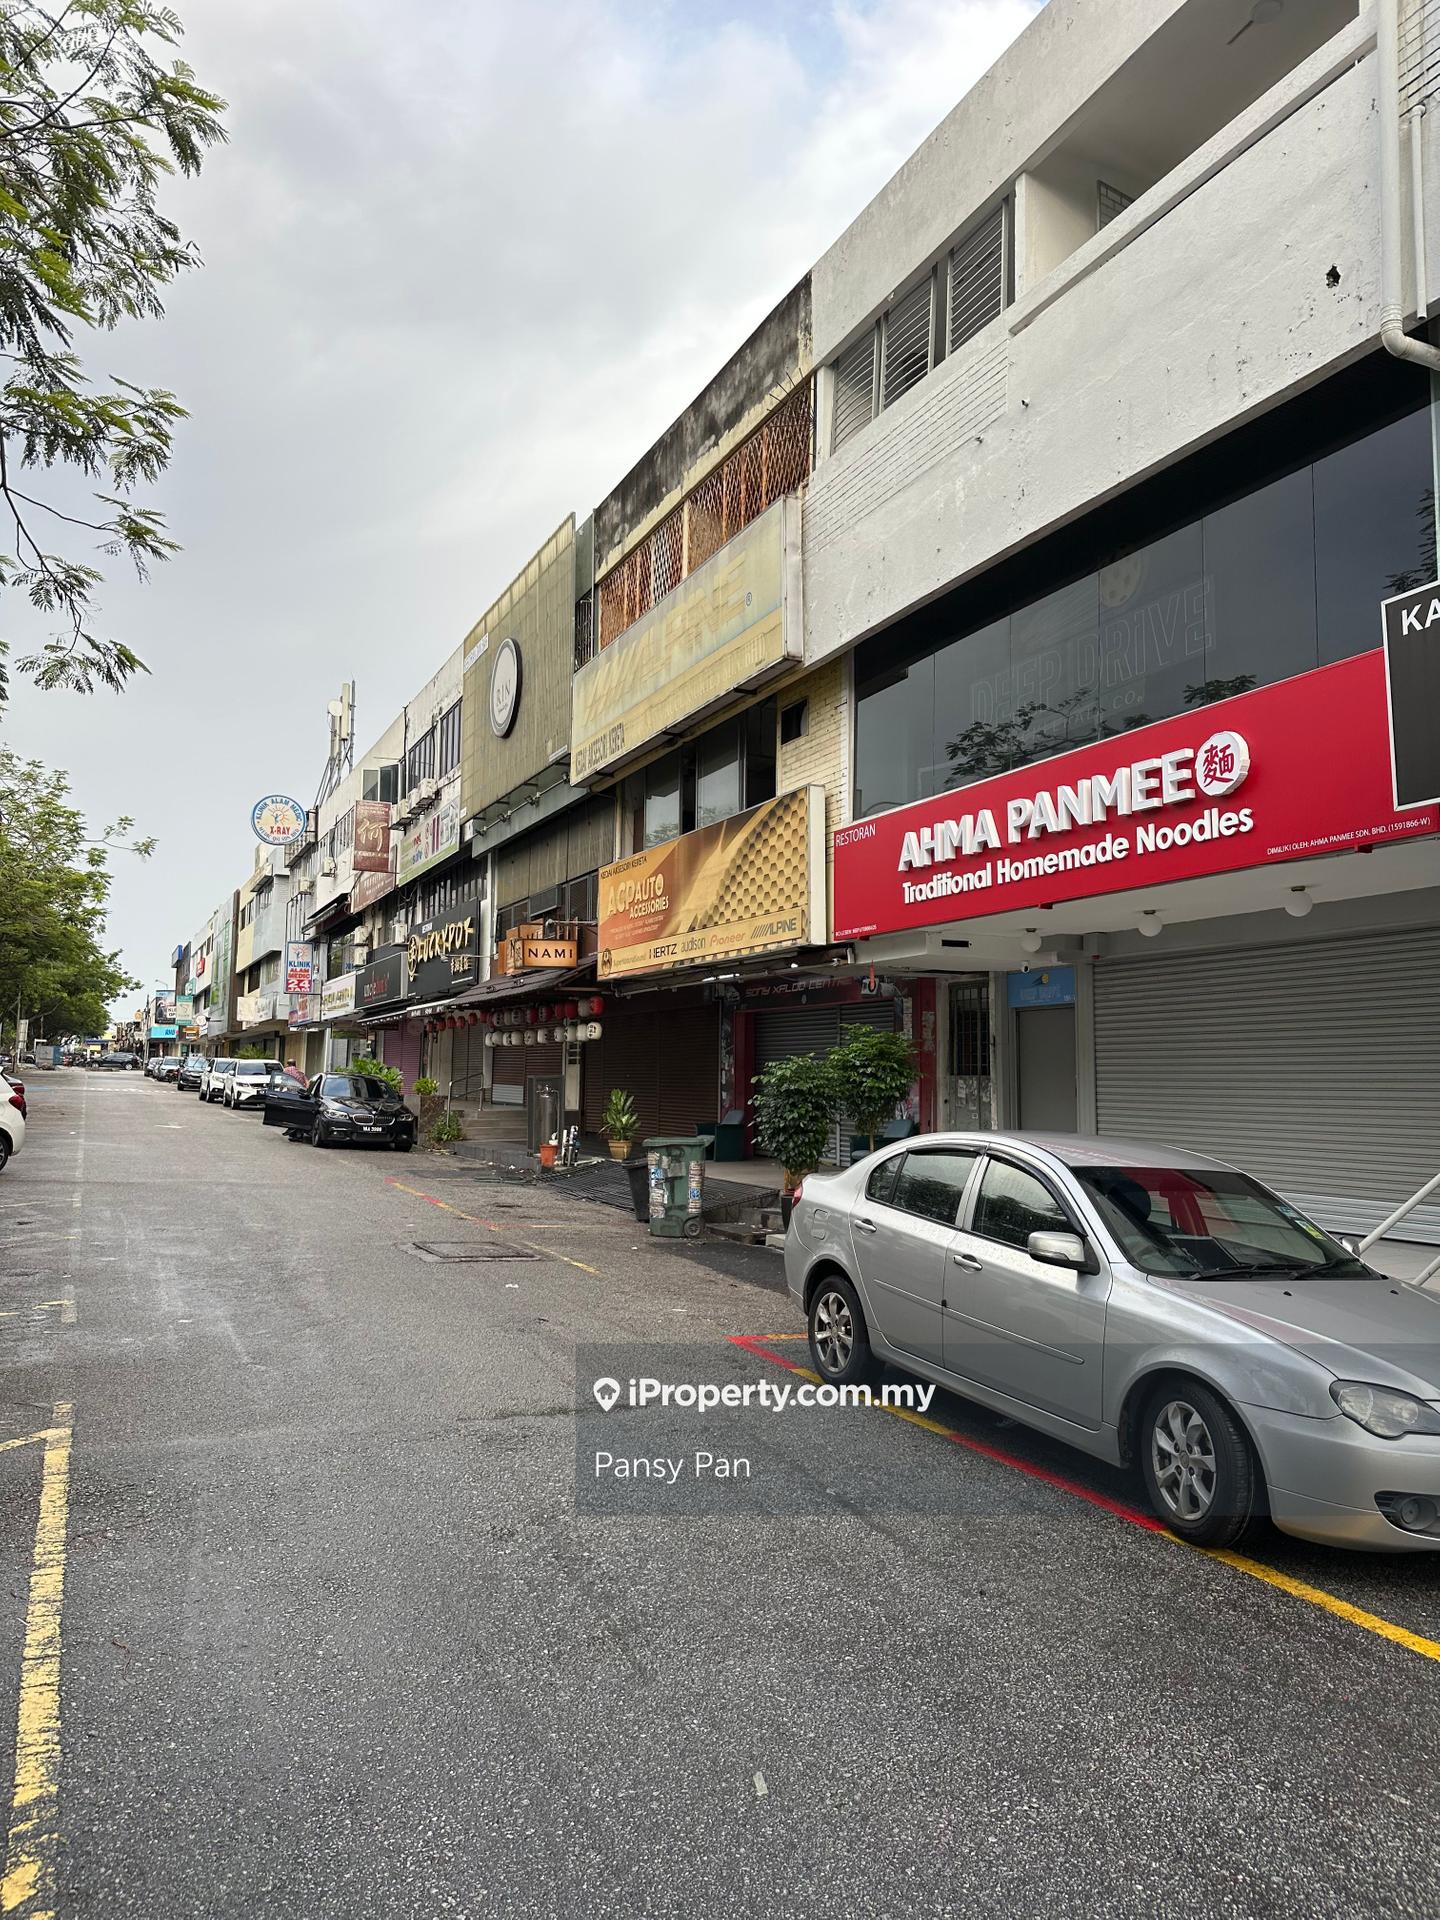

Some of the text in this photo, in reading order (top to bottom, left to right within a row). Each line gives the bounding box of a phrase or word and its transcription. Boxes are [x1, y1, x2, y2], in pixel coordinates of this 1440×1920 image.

[898, 747, 1196, 872] AHMA PANMEE
[270, 826, 291, 835] X-RAY
[836, 823, 876, 847] RESTORAN
[1310, 838, 1329, 847] AHMA
[1329, 832, 1355, 843] PANMEE
[1355, 828, 1371, 839] SDN.
[1371, 825, 1388, 835] BHD.
[902, 807, 1255, 904] Traditional Homemade Noodles
[629, 896, 669, 919] ACCESSORIES
[710, 931, 746, 948] Pioneer
[528, 948, 573, 958] NAMI
[288, 980, 310, 988] 24
